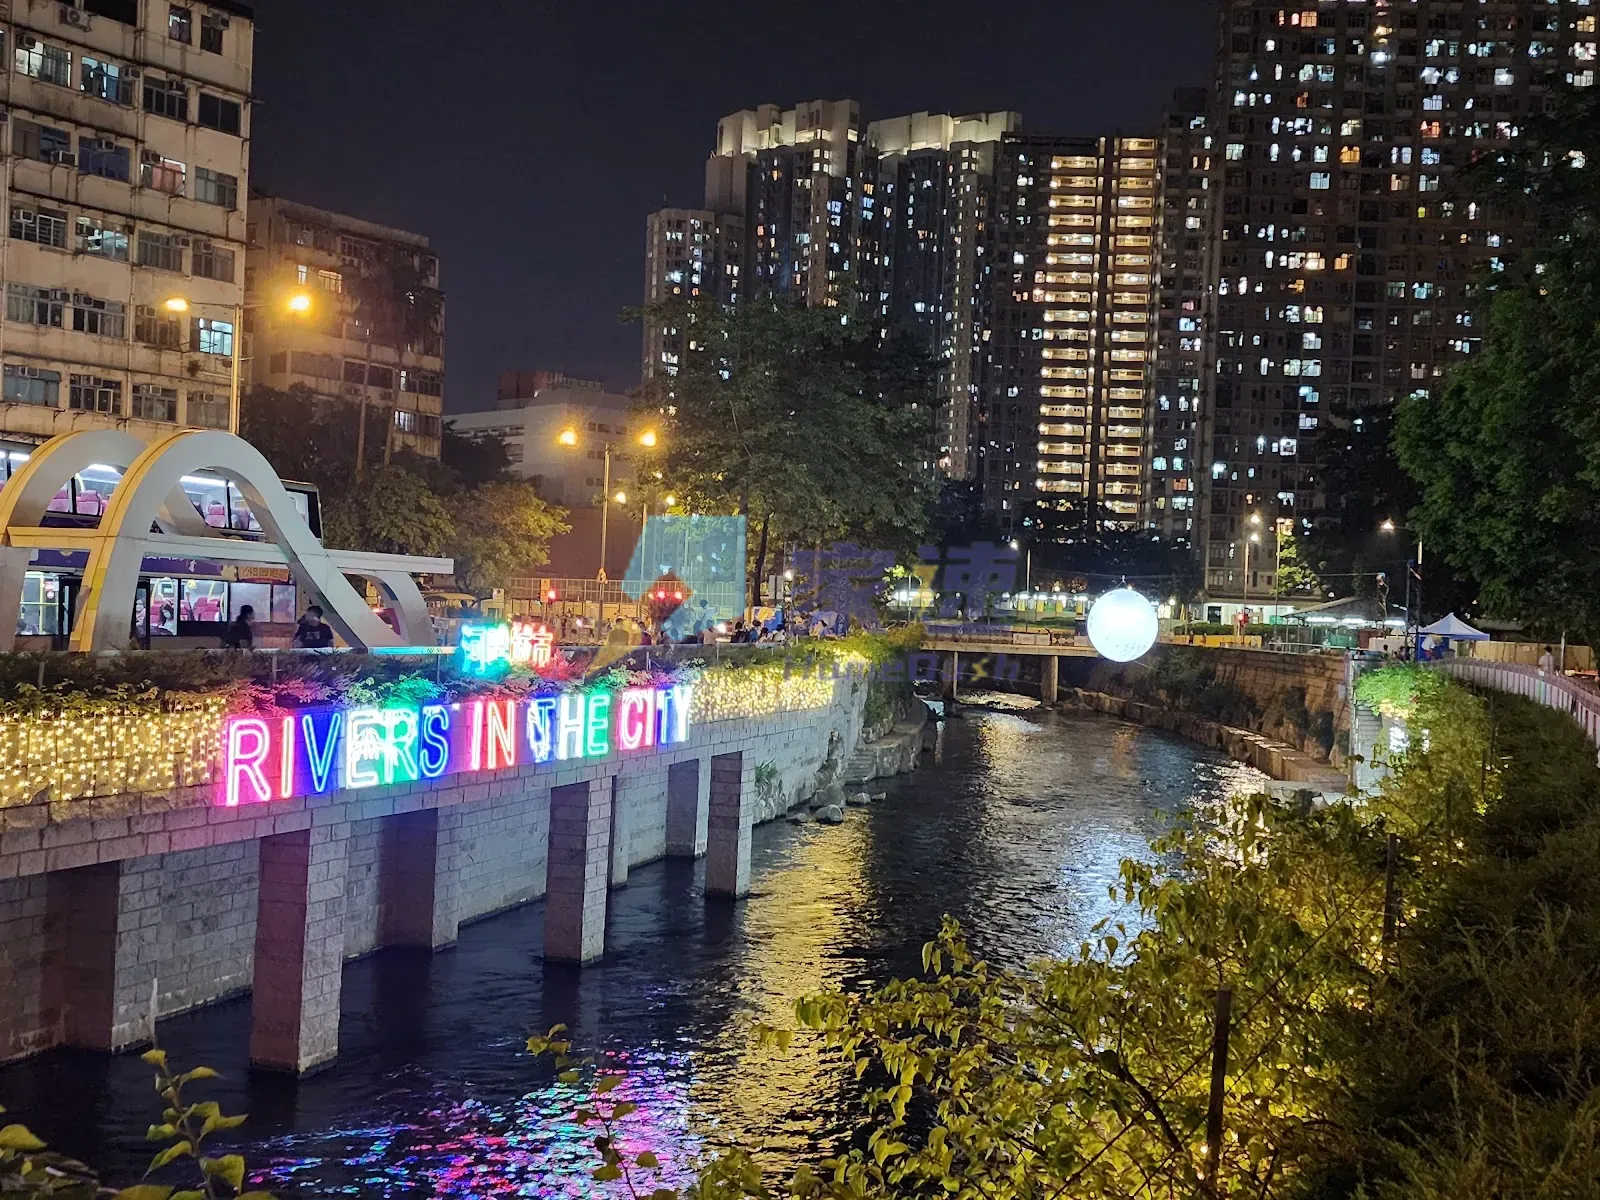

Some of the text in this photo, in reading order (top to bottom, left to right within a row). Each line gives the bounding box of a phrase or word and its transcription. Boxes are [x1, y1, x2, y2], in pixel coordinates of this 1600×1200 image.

[227, 685, 693, 806] RIVERS IN THE CITY
